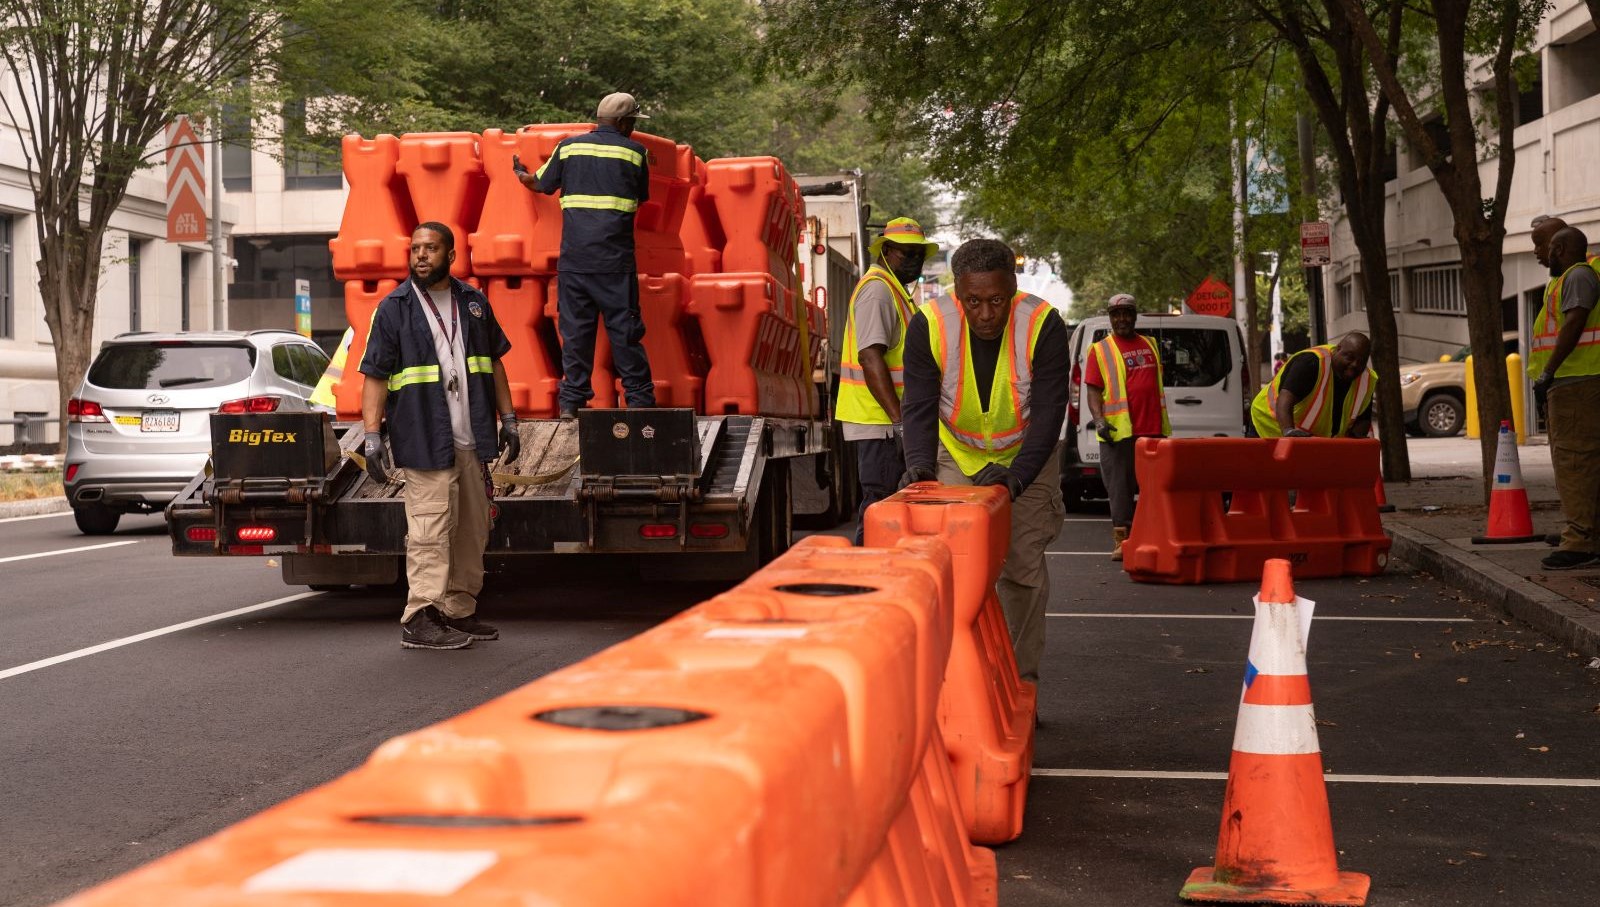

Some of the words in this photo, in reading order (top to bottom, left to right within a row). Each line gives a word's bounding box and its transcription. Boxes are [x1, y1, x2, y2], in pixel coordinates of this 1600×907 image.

[176, 213, 198, 223] ATL
[176, 223, 199, 234] DTN
[1197, 303, 1217, 311] 1000
[1220, 302, 1229, 310] FT
[145, 417, 176, 427] RZX6180
[229, 429, 297, 446] BigTex
